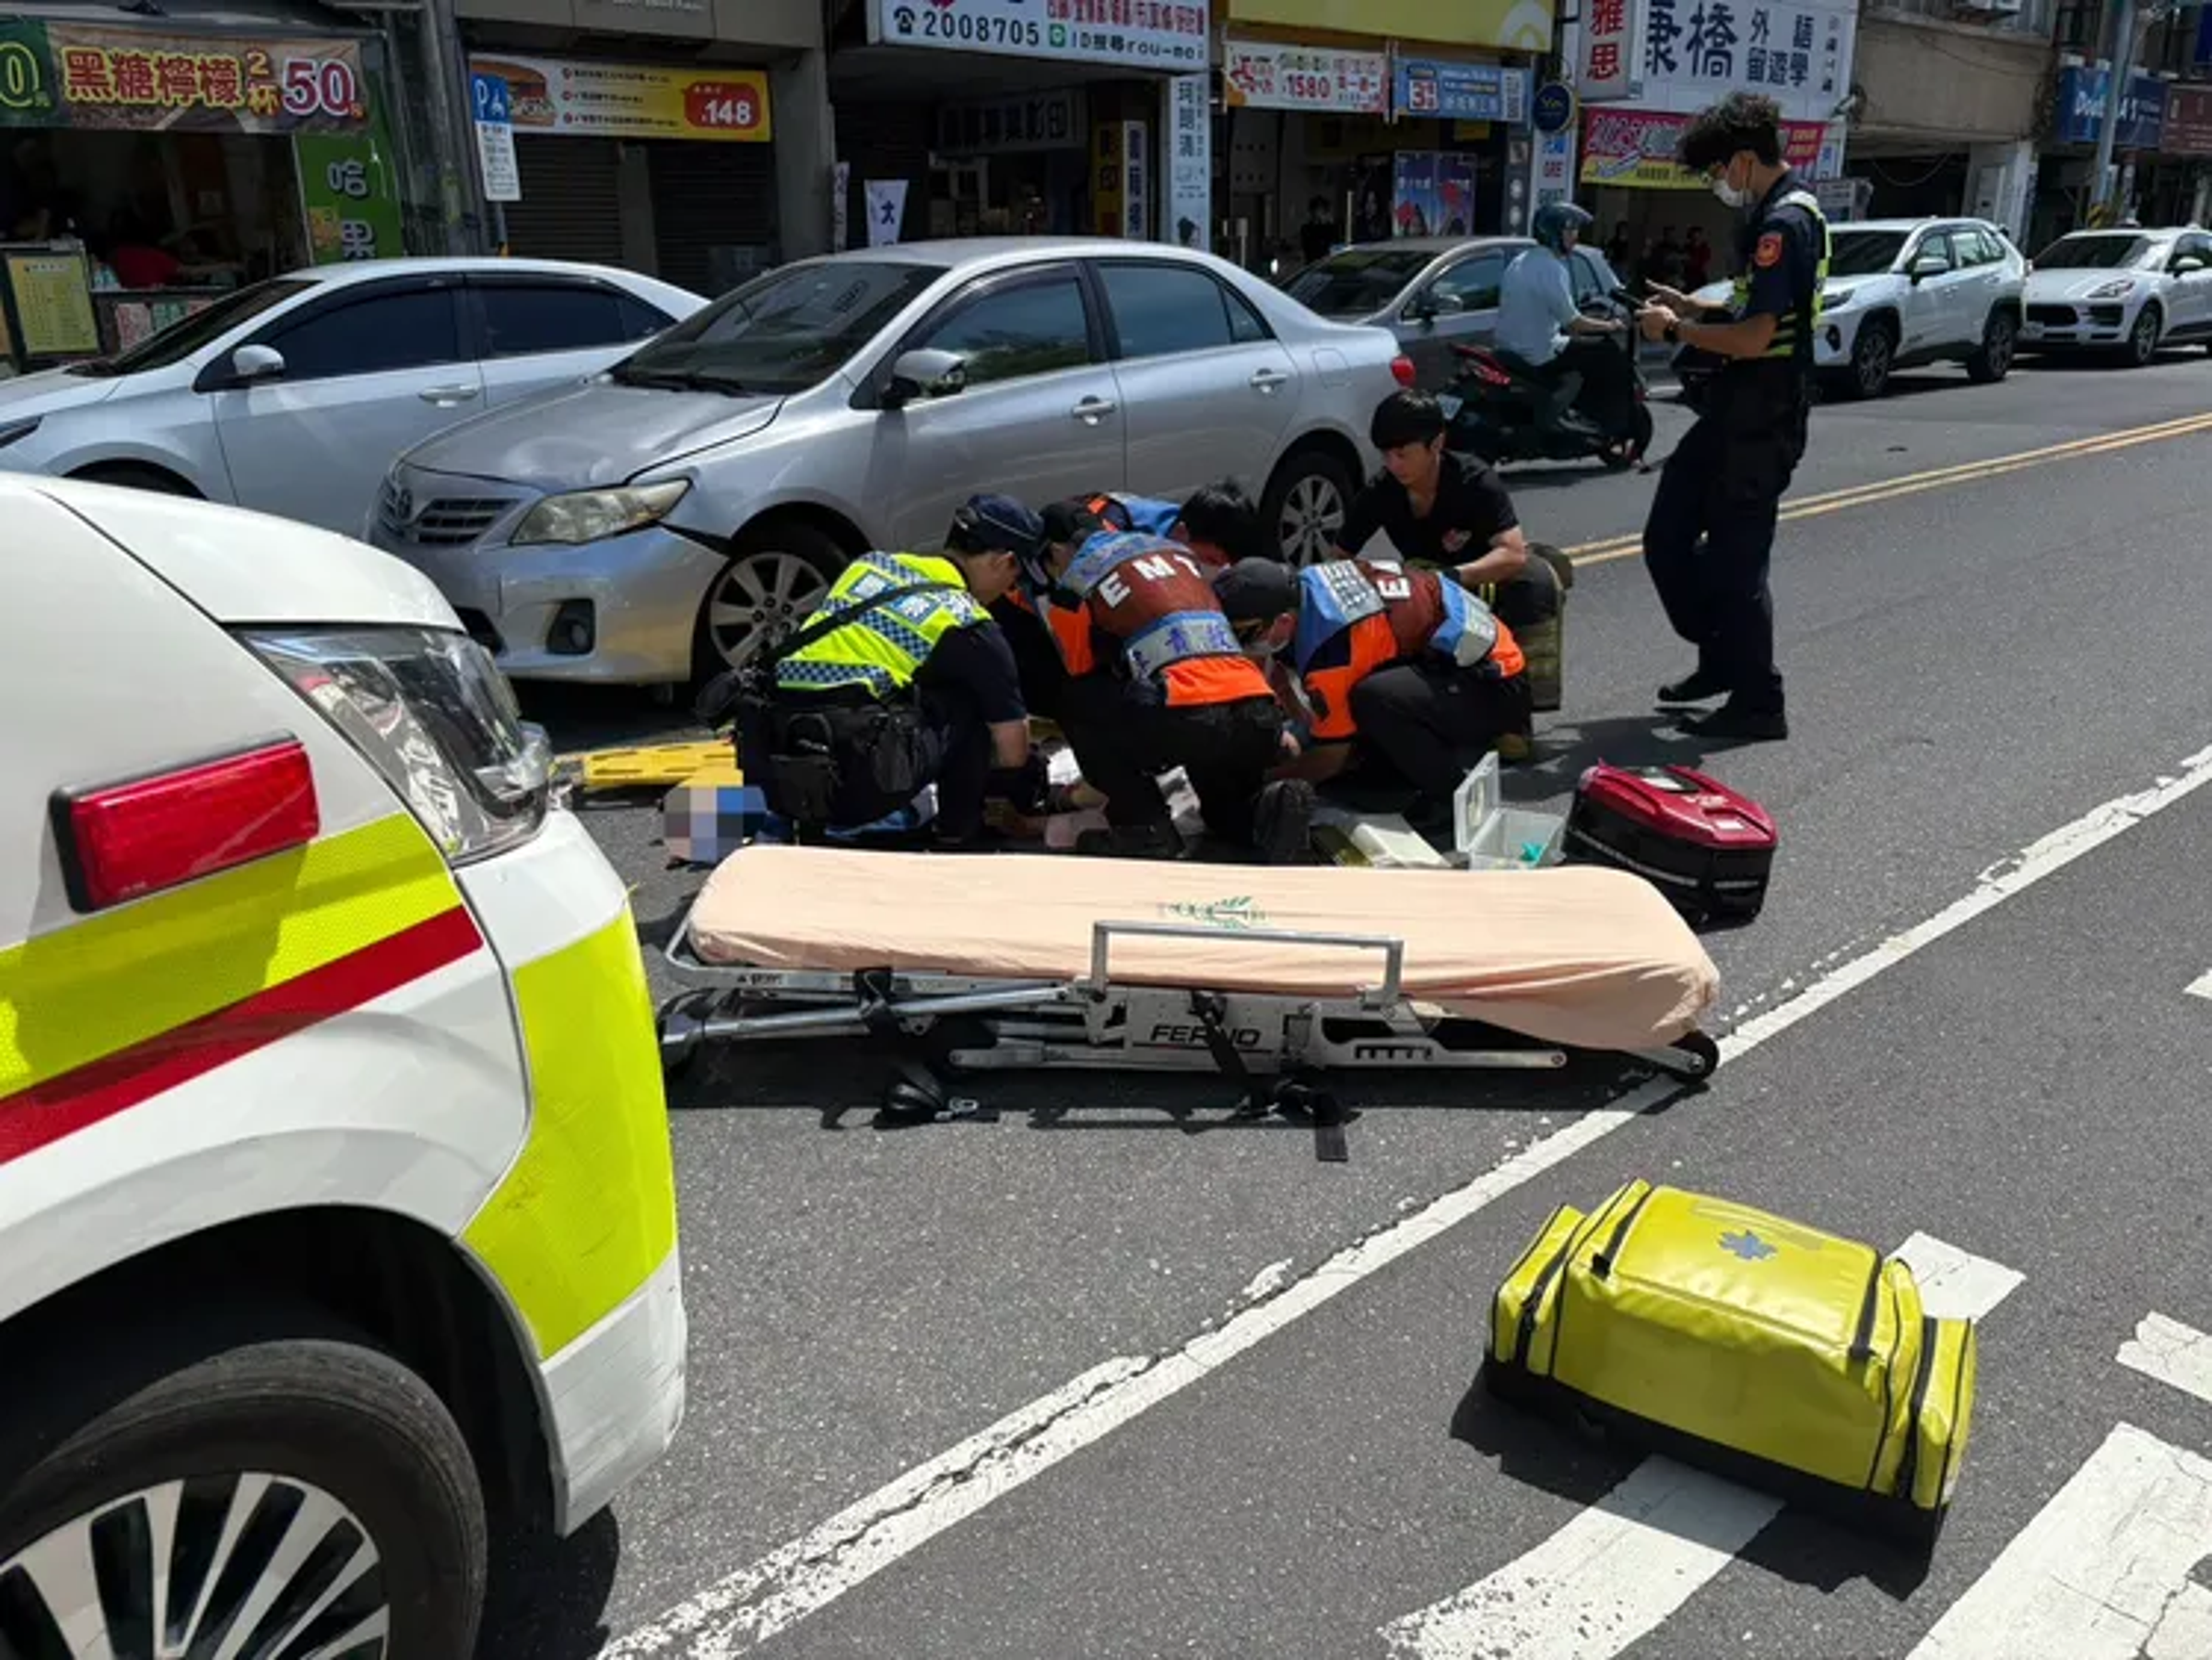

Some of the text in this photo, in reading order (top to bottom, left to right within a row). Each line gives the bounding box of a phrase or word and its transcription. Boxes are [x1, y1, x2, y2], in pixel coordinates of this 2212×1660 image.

[923, 10, 1040, 46] 2008705
[1586, 0, 1624, 80] 雅思
[62, 46, 245, 108] 黑糖檸檬
